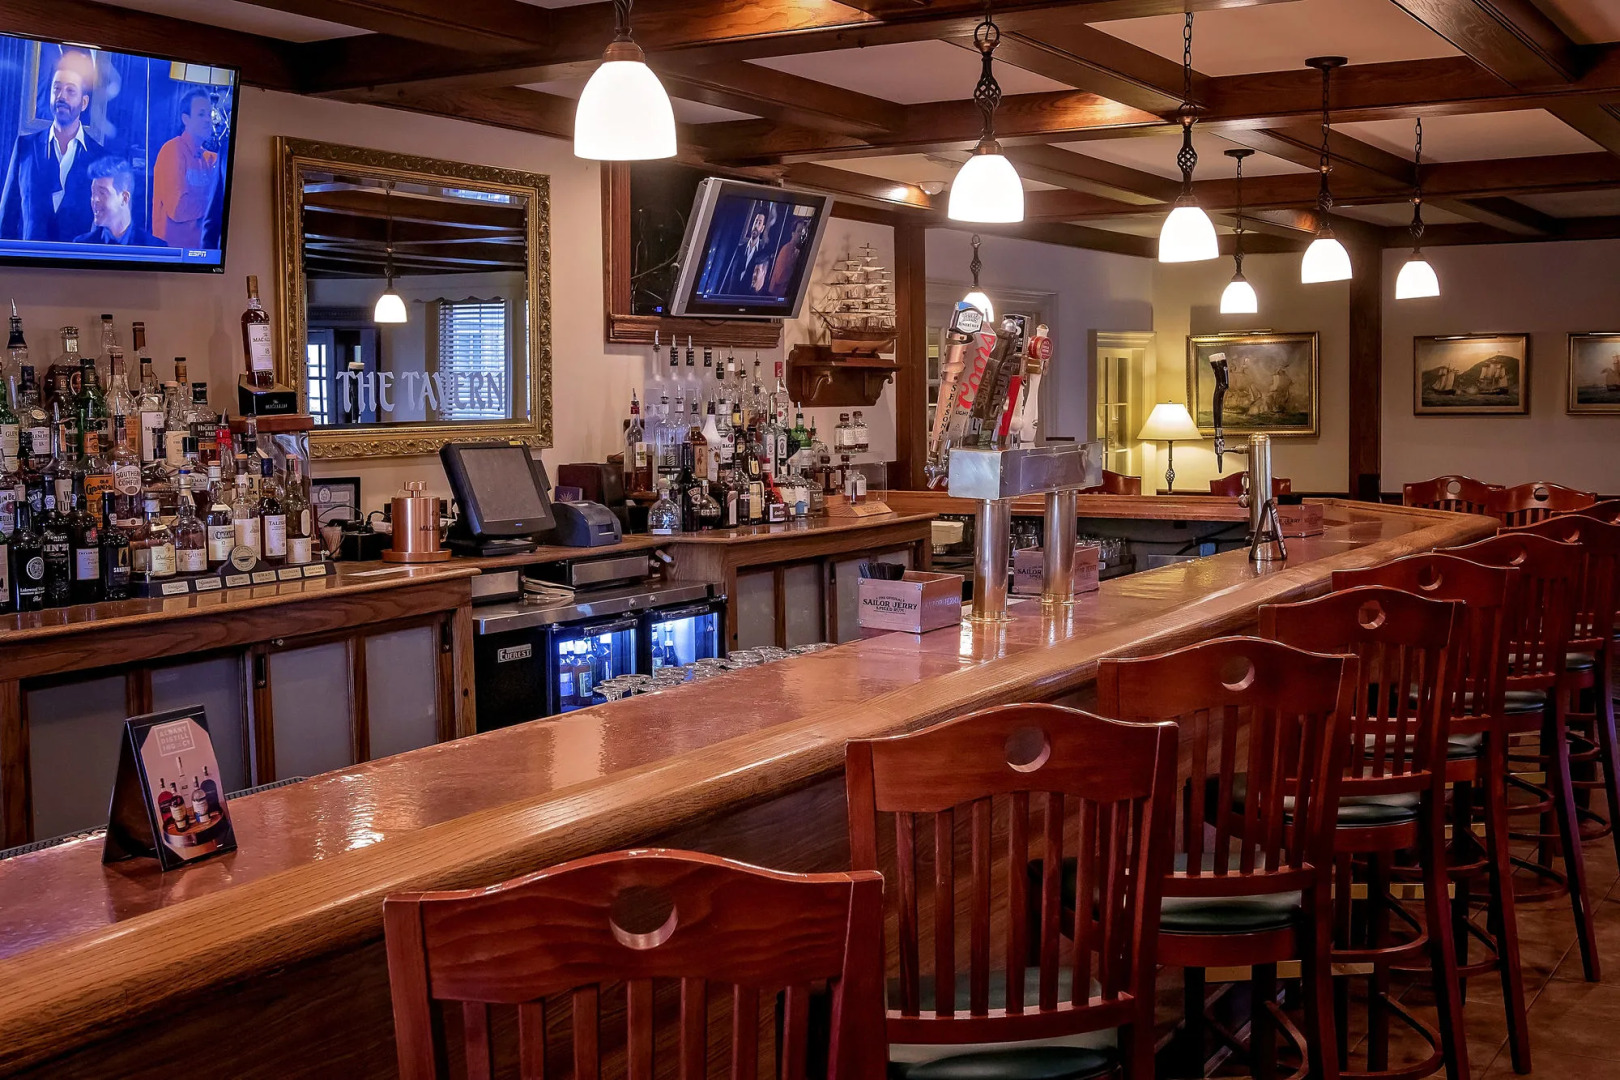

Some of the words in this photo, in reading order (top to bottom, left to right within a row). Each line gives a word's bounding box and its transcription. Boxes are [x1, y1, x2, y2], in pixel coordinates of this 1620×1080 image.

[188, 250, 207, 258] ESPN
[956, 333, 997, 410] Coors
[335, 371, 395, 413] THE
[401, 370, 502, 412] TAVERN
[115, 470, 141, 479] SOUTHER
[862, 598, 890, 608] SAILOR
[892, 602, 918, 611] JERRY
